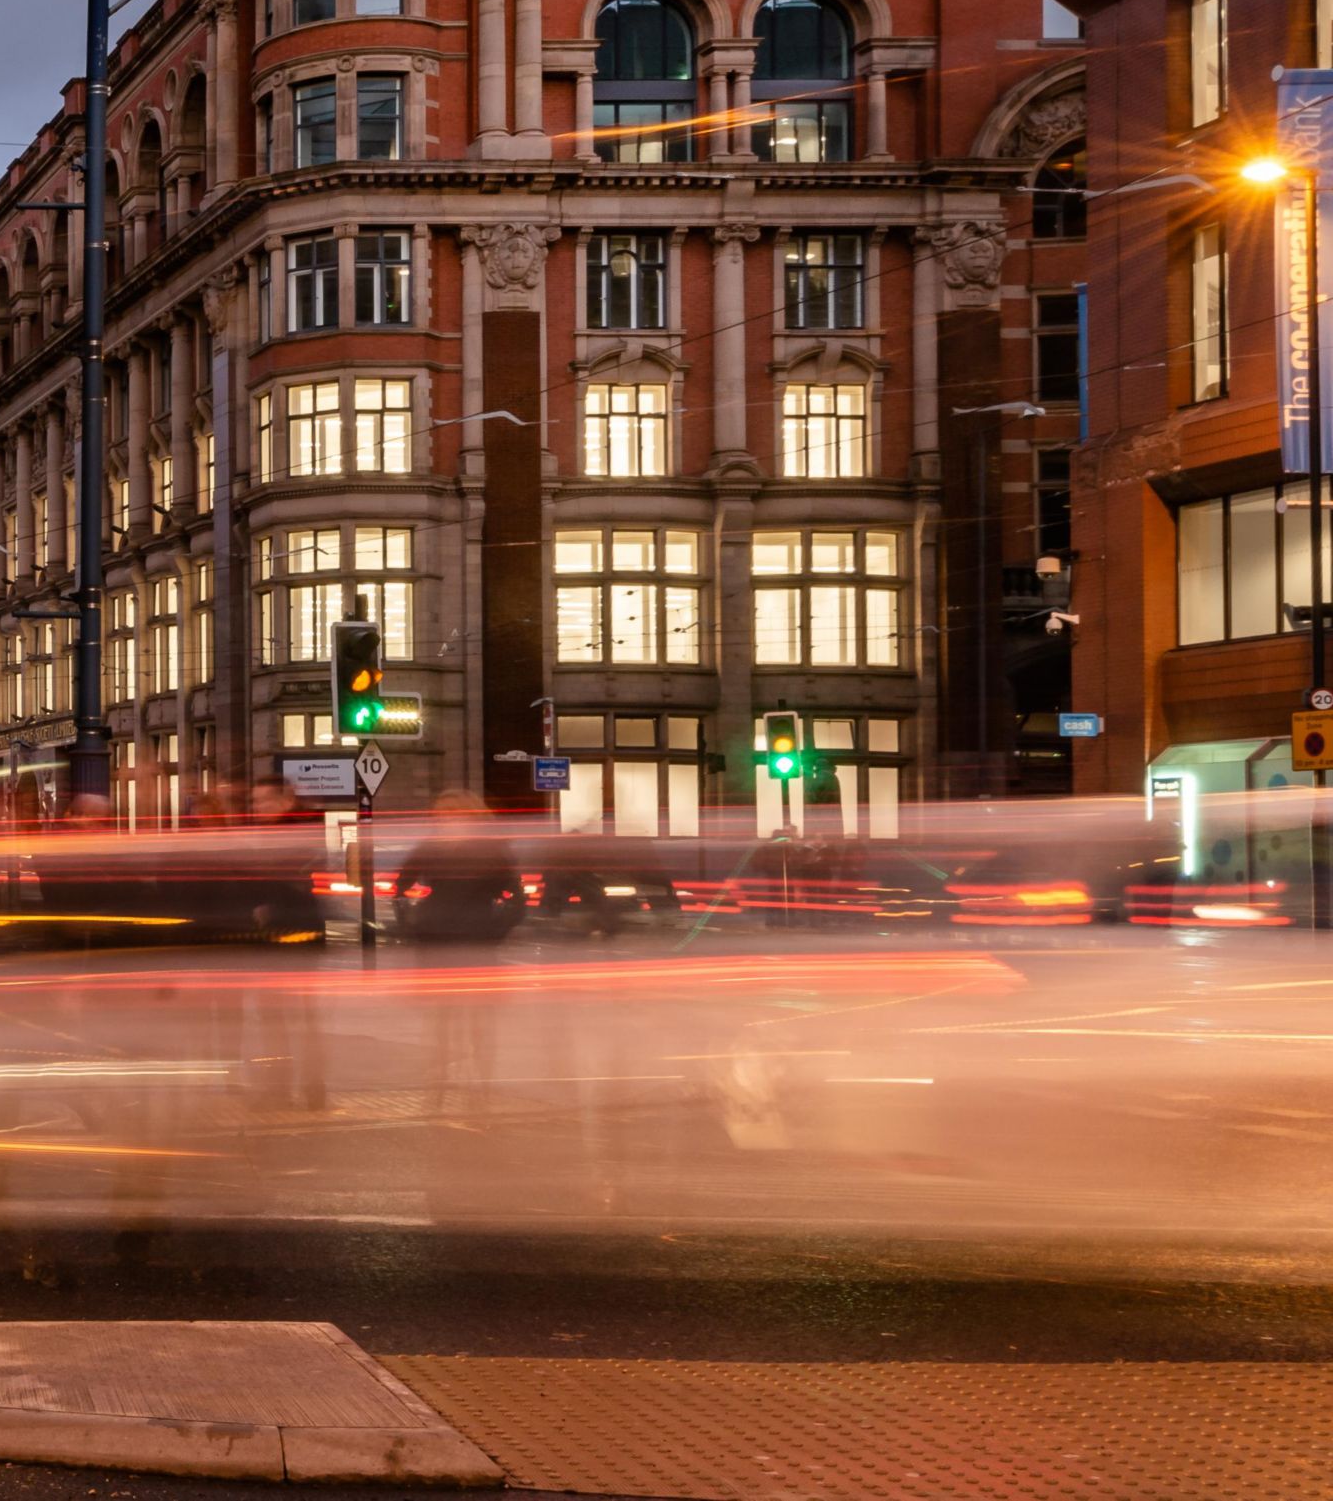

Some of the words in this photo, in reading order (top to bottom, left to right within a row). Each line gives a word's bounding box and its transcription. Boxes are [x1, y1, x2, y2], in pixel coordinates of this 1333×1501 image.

[1283, 375, 1310, 429] The
[1314, 694, 1332, 705] 20
[1064, 720, 1093, 731] cash
[362, 758, 382, 774] 10
